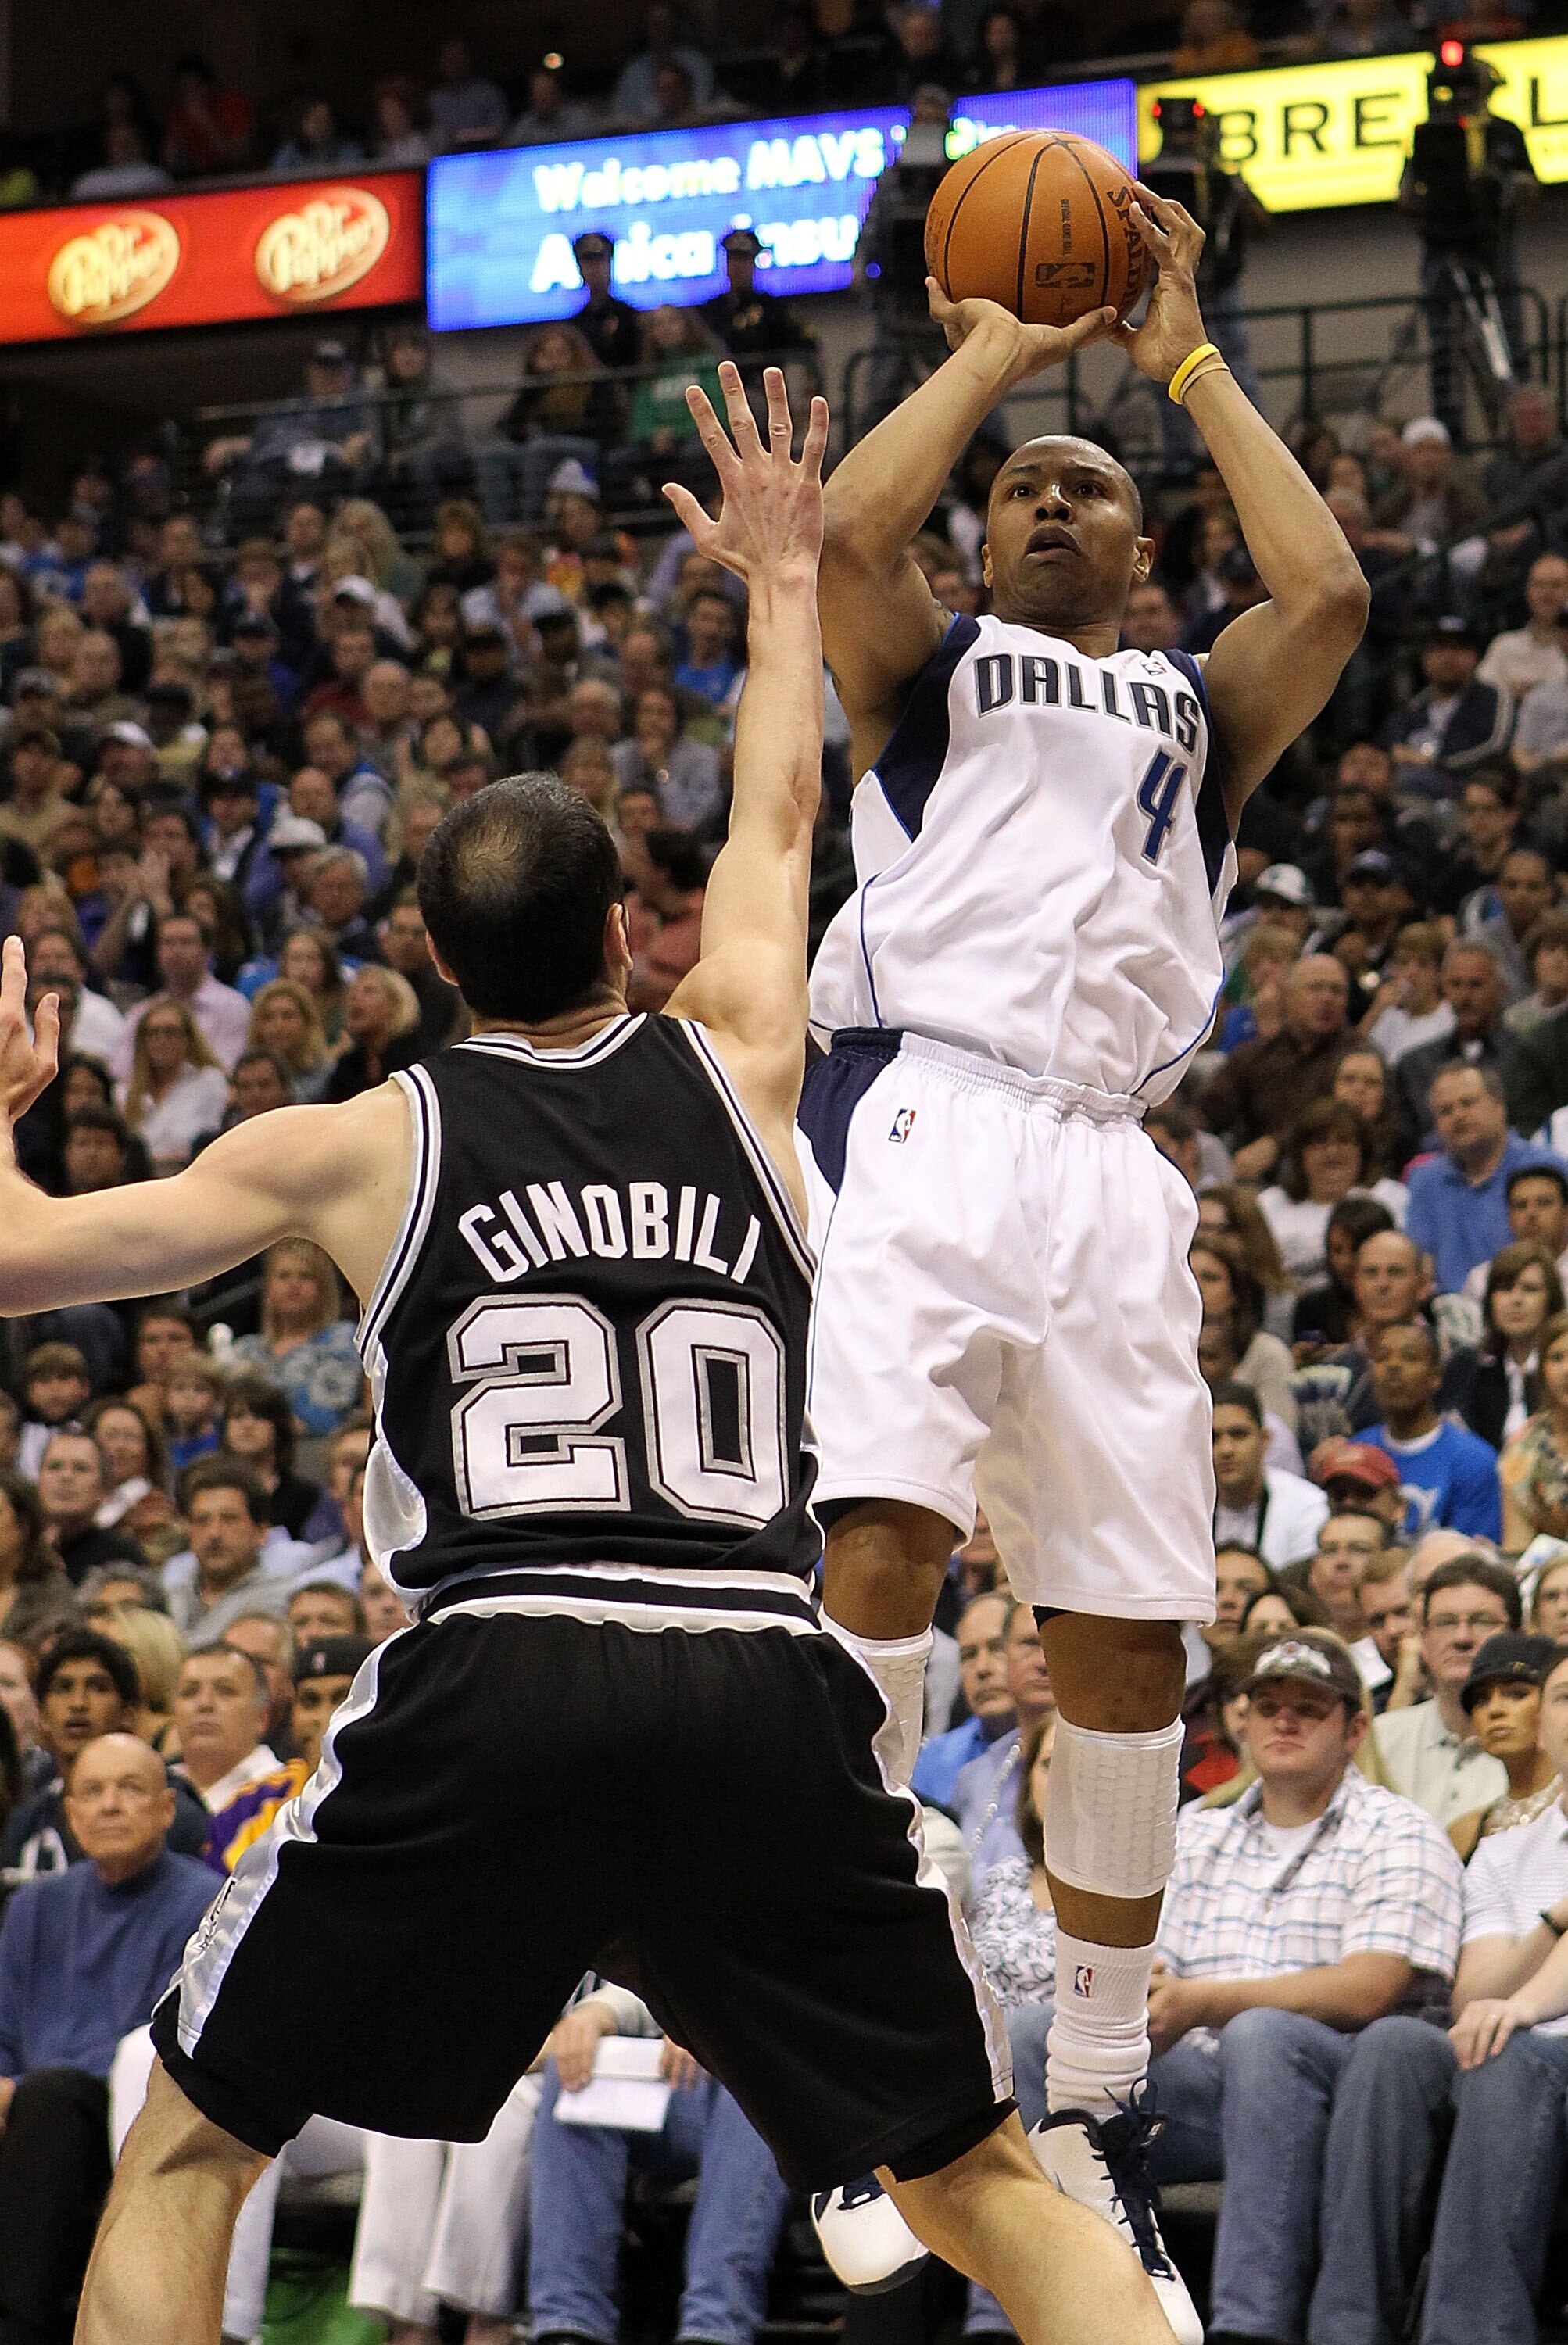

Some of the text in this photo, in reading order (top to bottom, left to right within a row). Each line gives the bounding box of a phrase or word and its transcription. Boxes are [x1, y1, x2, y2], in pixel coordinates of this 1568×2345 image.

[534, 158, 740, 213] Welcome
[746, 127, 886, 190] MAVS
[974, 653, 1201, 756] DALLAS
[1137, 747, 1188, 867] 4
[457, 1180, 761, 1284] GINOBILI
[446, 1293, 790, 1531] 20
